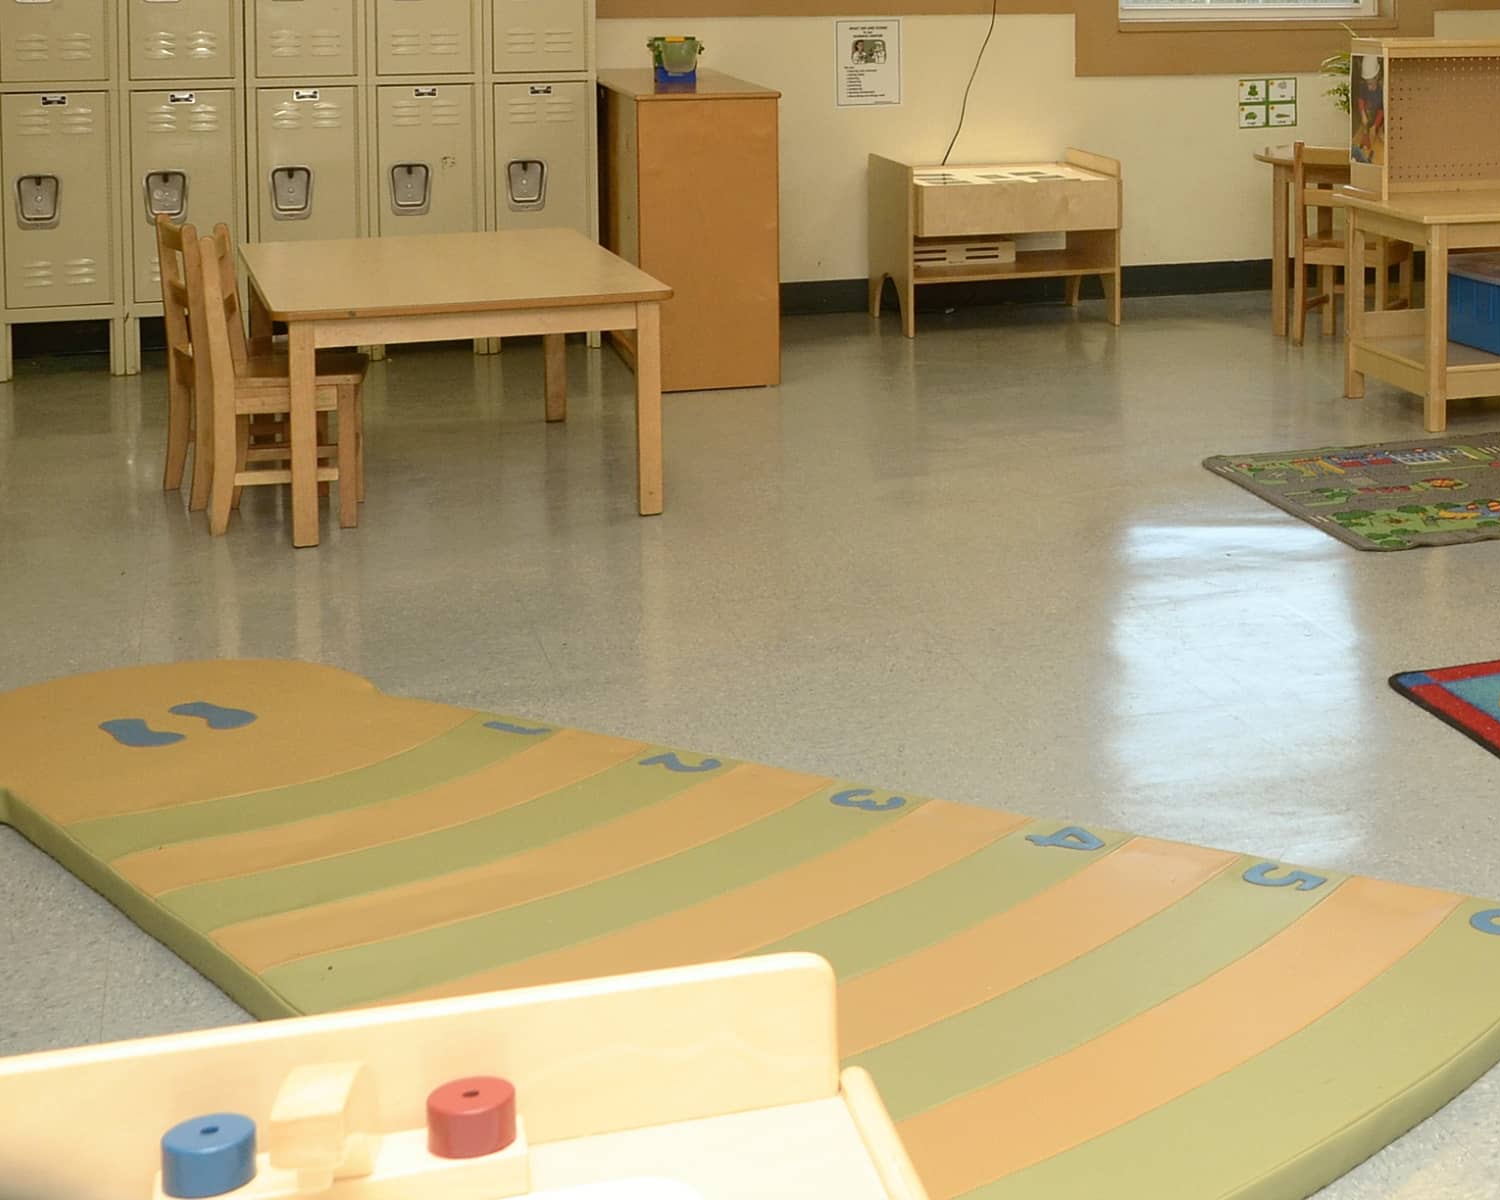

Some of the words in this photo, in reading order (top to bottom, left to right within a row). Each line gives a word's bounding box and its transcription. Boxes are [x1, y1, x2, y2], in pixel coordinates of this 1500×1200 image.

[829, 787, 907, 813] 3
[1025, 825, 1106, 852] 4
[1242, 861, 1328, 893] 5
